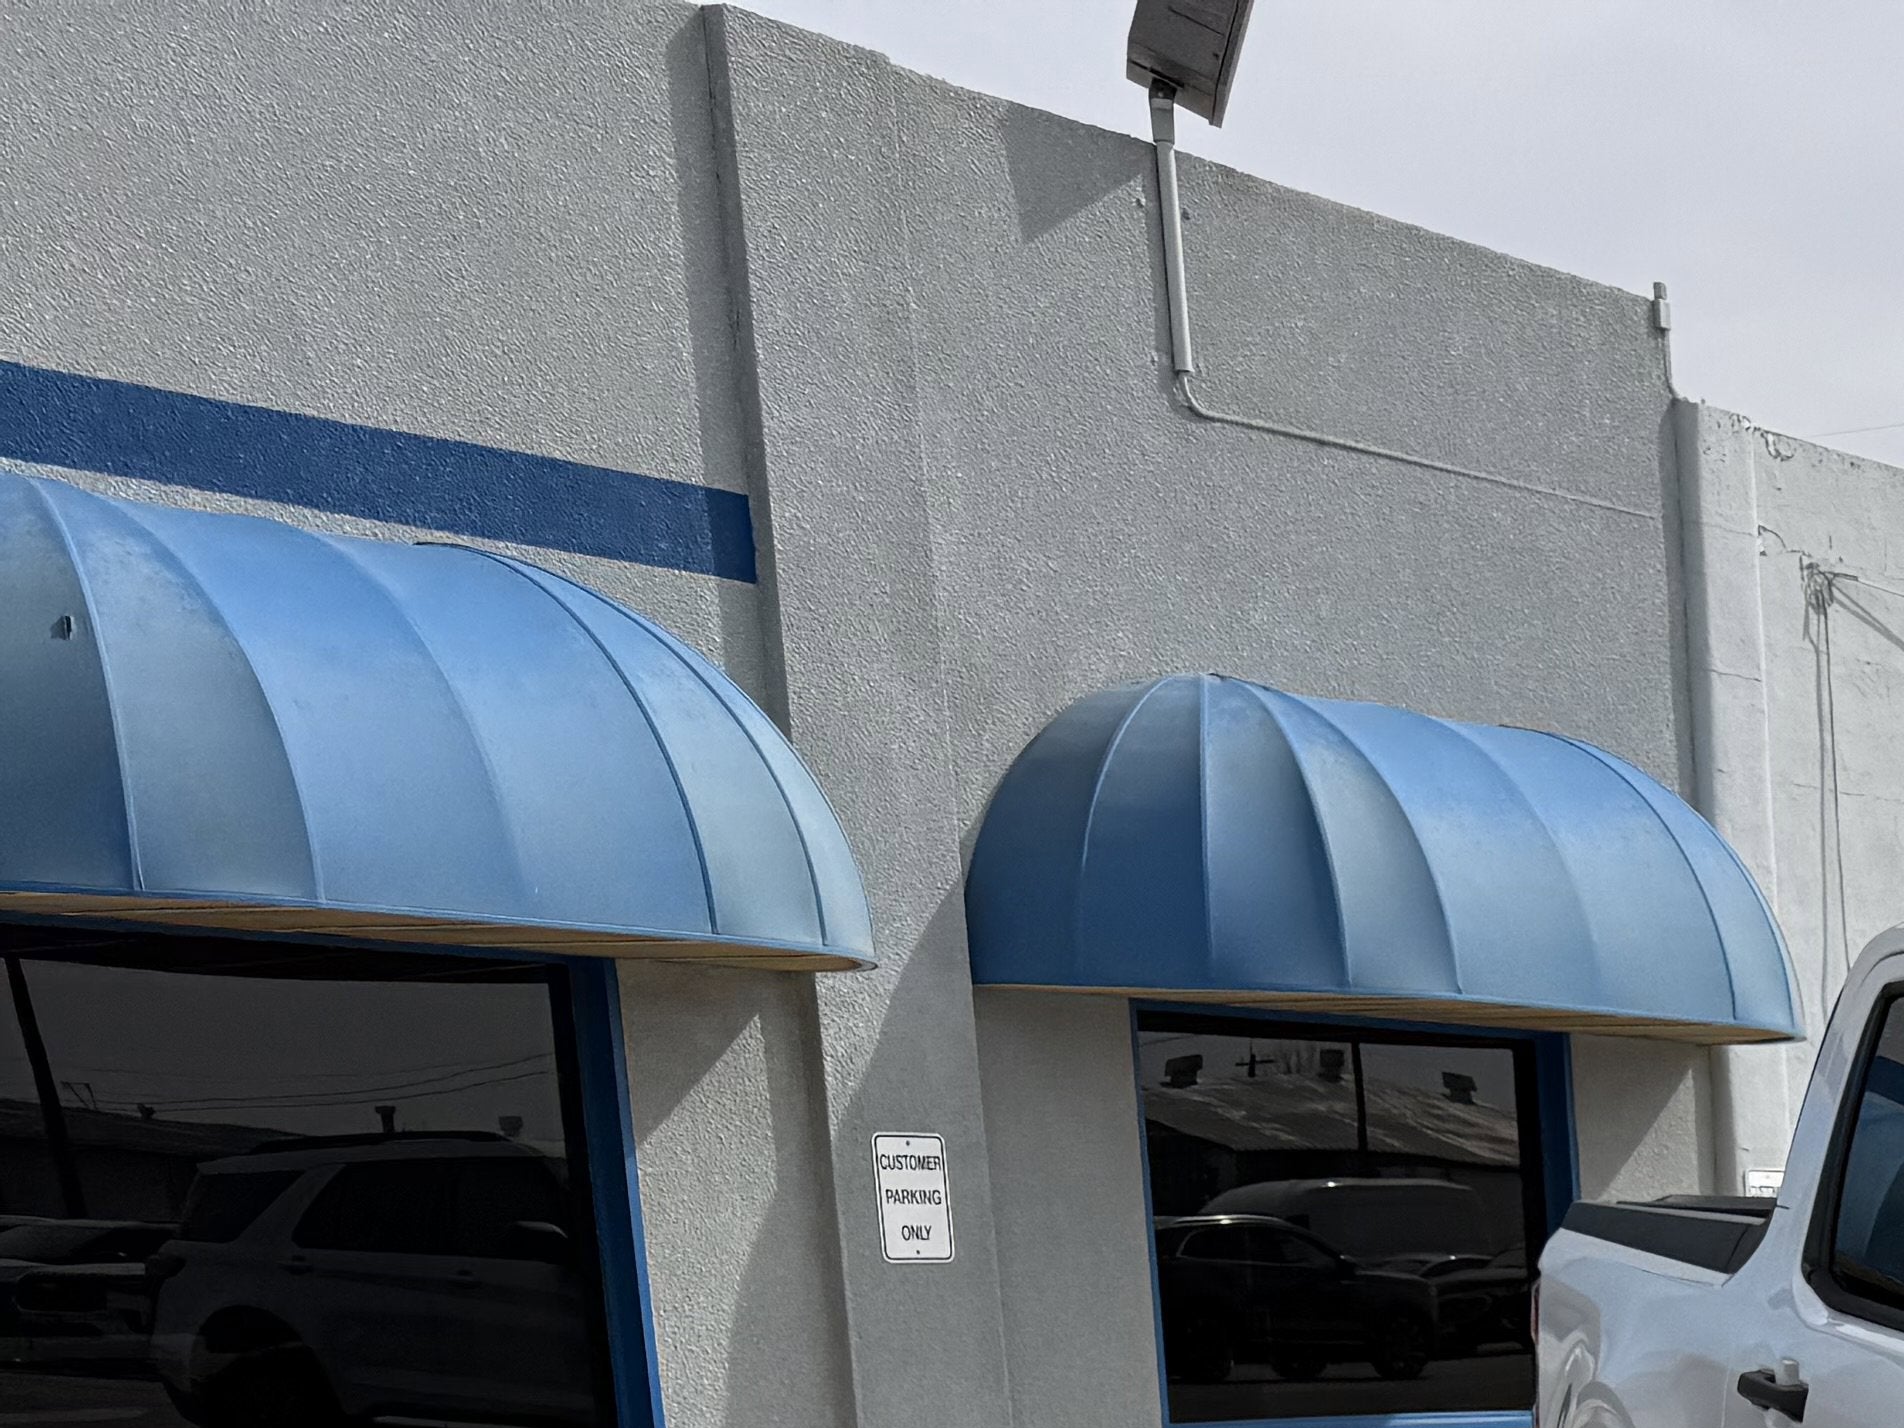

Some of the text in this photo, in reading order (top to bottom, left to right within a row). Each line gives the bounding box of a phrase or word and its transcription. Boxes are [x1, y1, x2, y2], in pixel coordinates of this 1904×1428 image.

[879, 1153, 942, 1171] CUSTOMER
[885, 1188, 942, 1206] PARKING
[901, 1224, 932, 1241] ONLY
